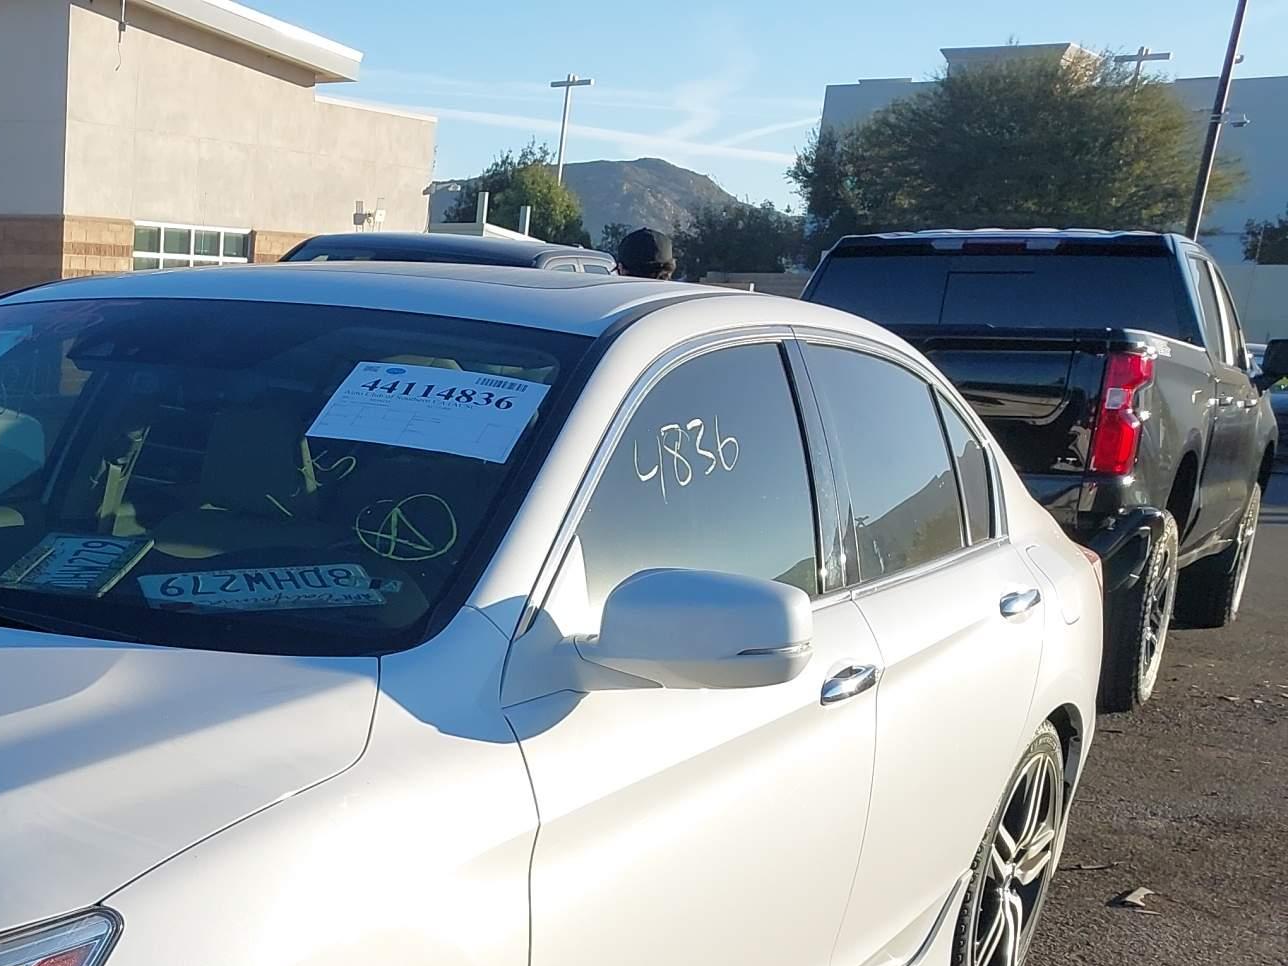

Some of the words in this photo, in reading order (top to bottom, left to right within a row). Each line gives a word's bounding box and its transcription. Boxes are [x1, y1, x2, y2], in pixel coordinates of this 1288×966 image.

[361, 378, 515, 410] 44114836
[634, 415, 740, 505] 4836
[159, 566, 354, 598] 8DHW279
